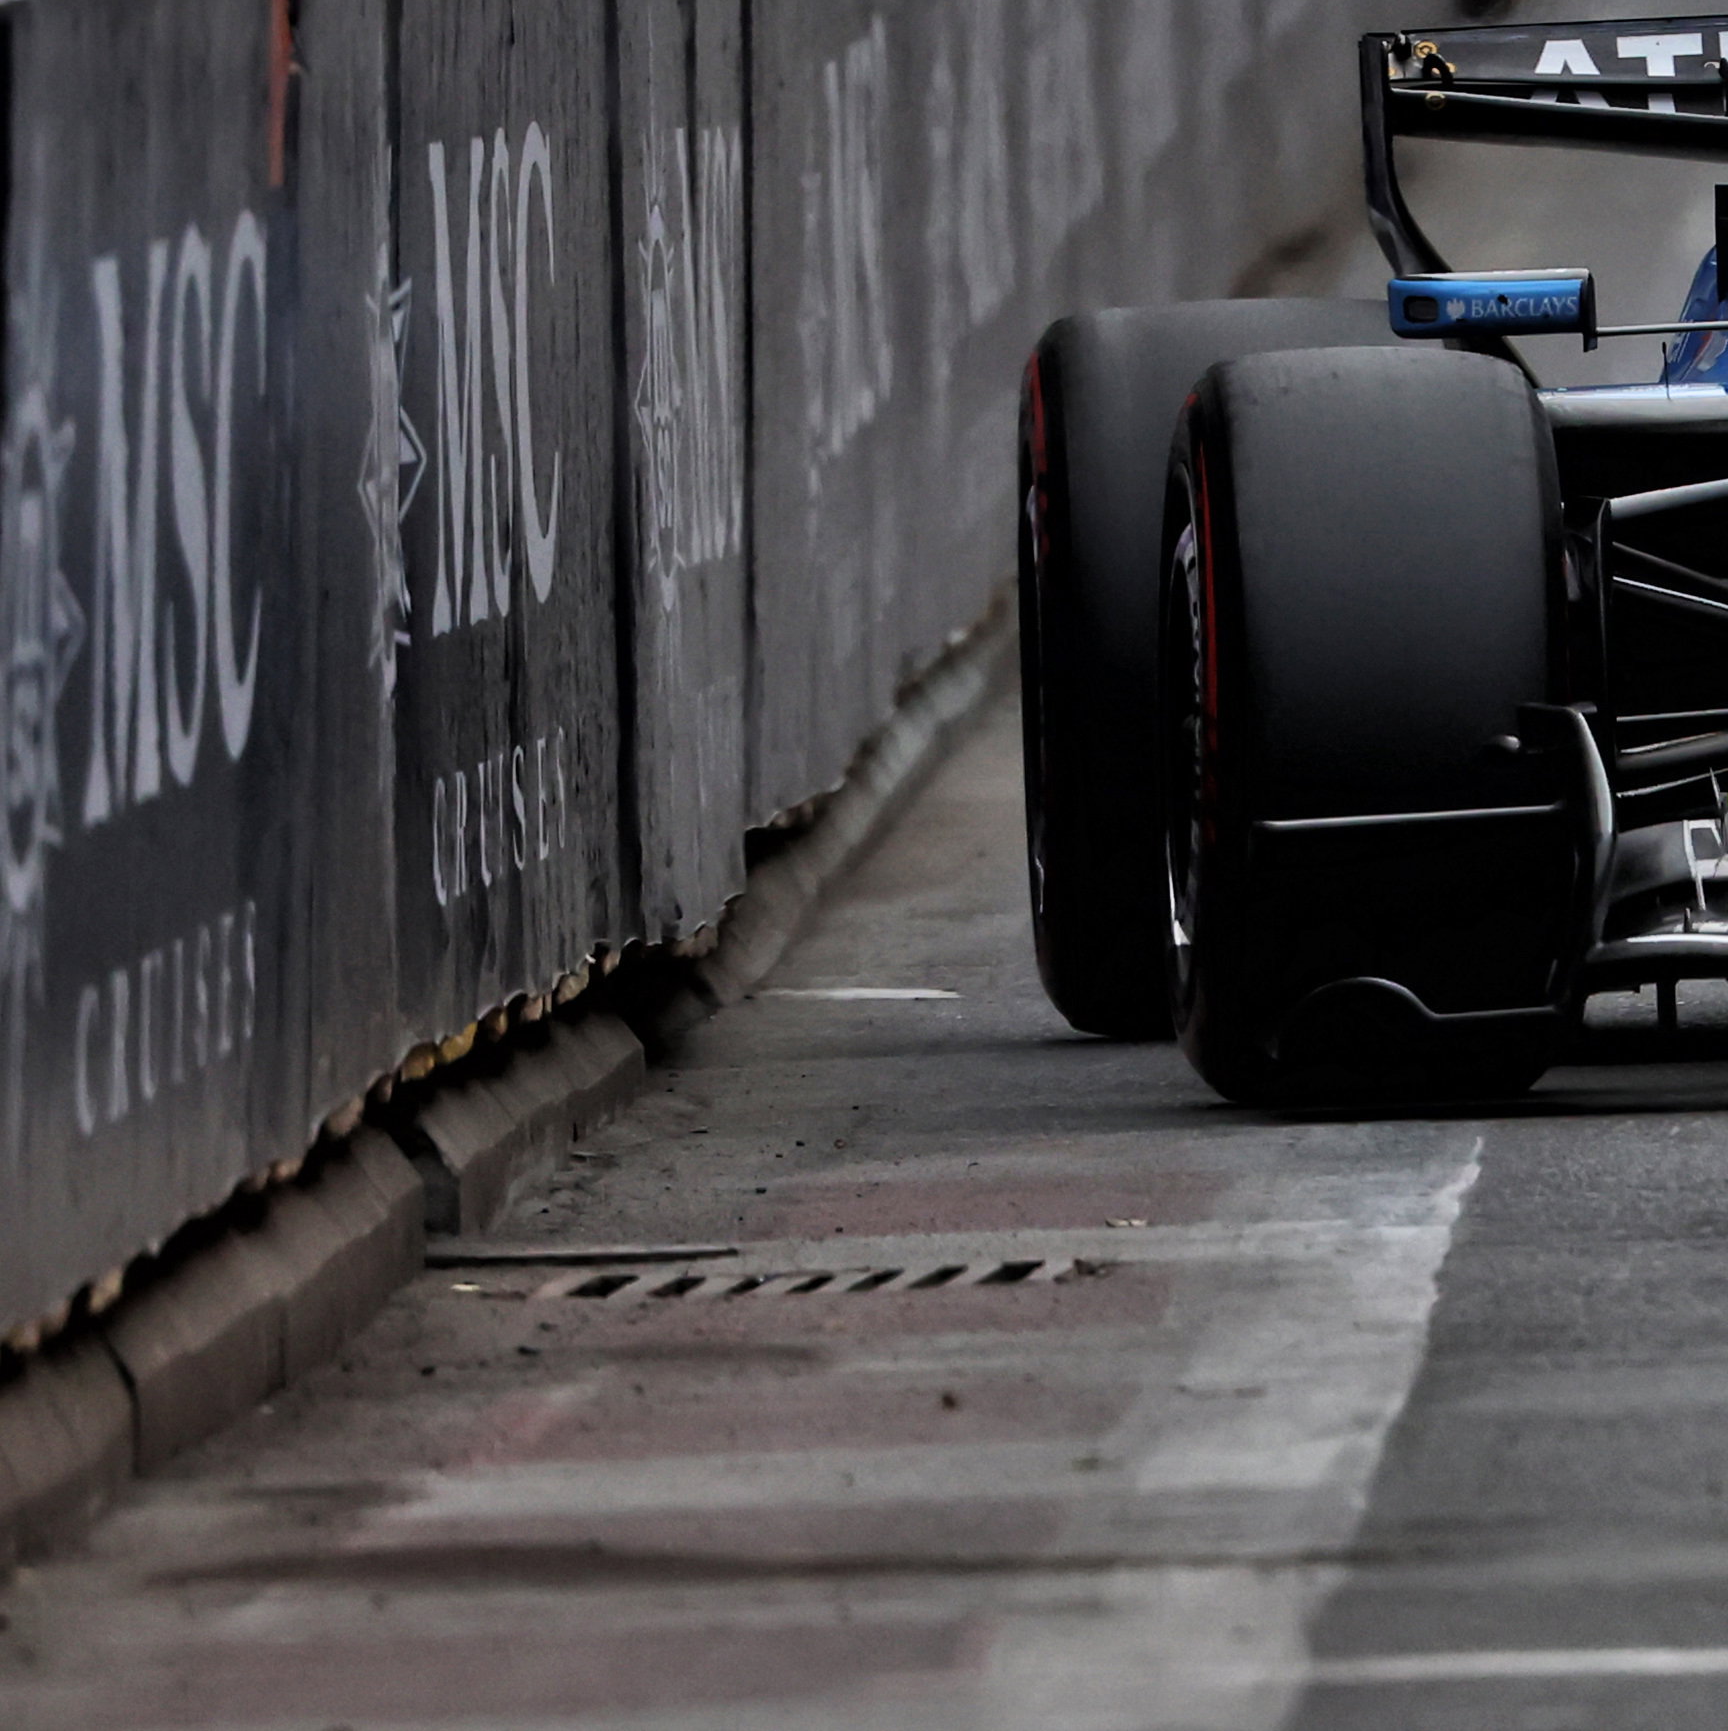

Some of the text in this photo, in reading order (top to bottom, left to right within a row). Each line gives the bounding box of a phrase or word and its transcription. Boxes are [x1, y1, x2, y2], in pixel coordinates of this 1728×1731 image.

[427, 119, 562, 638] MSC
[1470, 294, 1579, 320] BARCLAYS
[84, 210, 267, 828] MSC
[432, 724, 570, 908] CRUISES
[76, 900, 257, 1138] CRUISES
